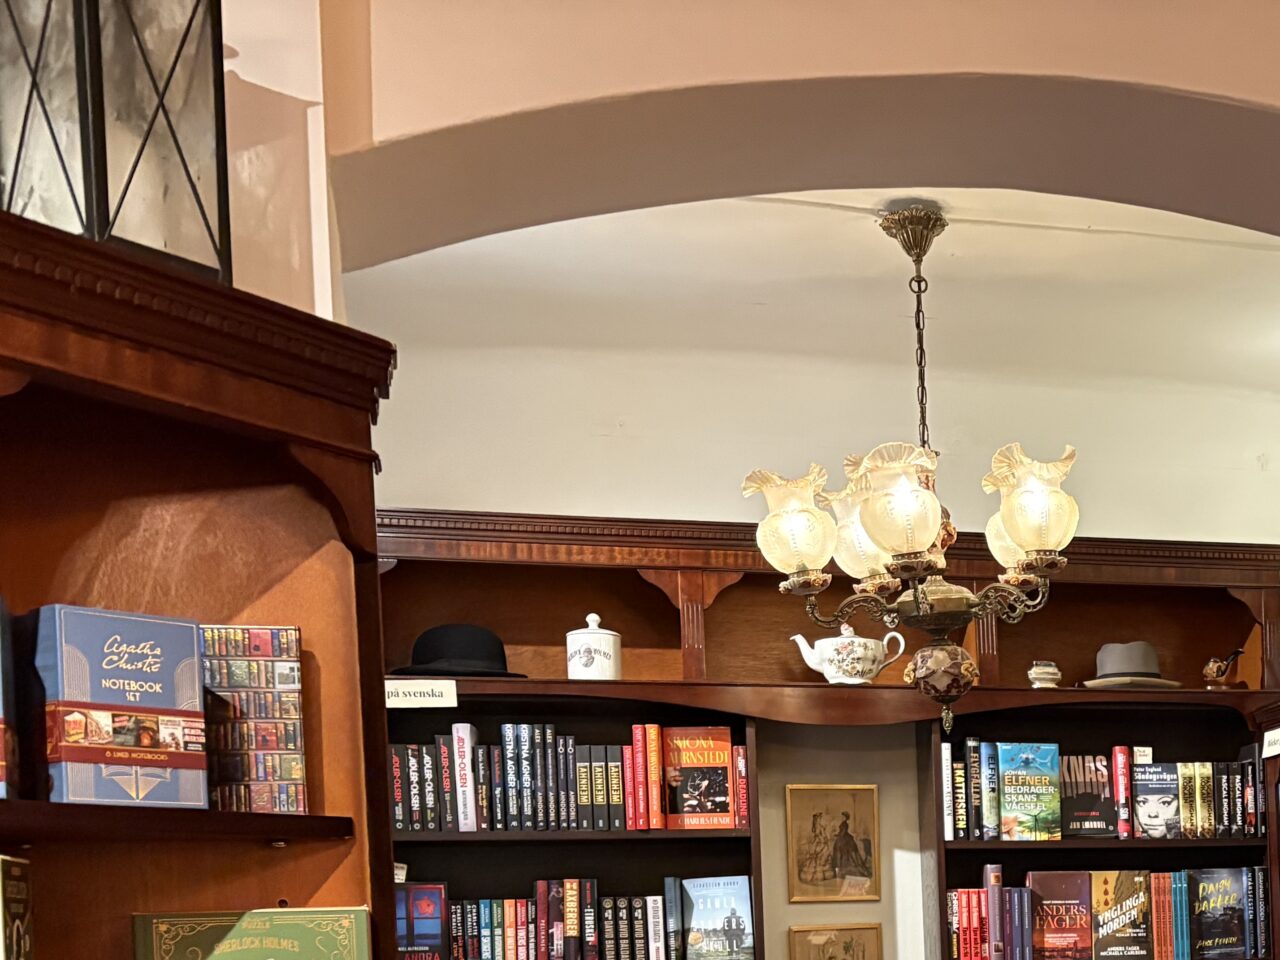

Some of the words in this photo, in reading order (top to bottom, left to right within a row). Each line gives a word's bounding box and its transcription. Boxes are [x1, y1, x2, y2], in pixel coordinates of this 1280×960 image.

[103, 634, 161, 657] Agatha
[102, 654, 161, 673] Christie
[102, 679, 163, 693] NOTEBOOK
[126, 690, 140, 703] SET
[387, 689, 400, 700] på
[402, 688, 444, 699] svenska
[667, 735, 715, 750] SIMONA
[457, 735, 468, 789] ADLER-OLSEN
[1004, 776, 1050, 786] ELFNER
[739, 778, 748, 817] DEADLINE
[1004, 786, 1058, 794] BEDRAGER-
[1005, 794, 1037, 802] SKANS
[567, 886, 578, 937] AXBERGER
[1034, 904, 1088, 915] ANDERS
[1098, 891, 1146, 926] YNGLINGA
[1035, 915, 1088, 929] FAGER
[1098, 909, 1138, 938] MORDEN
[261, 935, 301, 953] HOLMES
